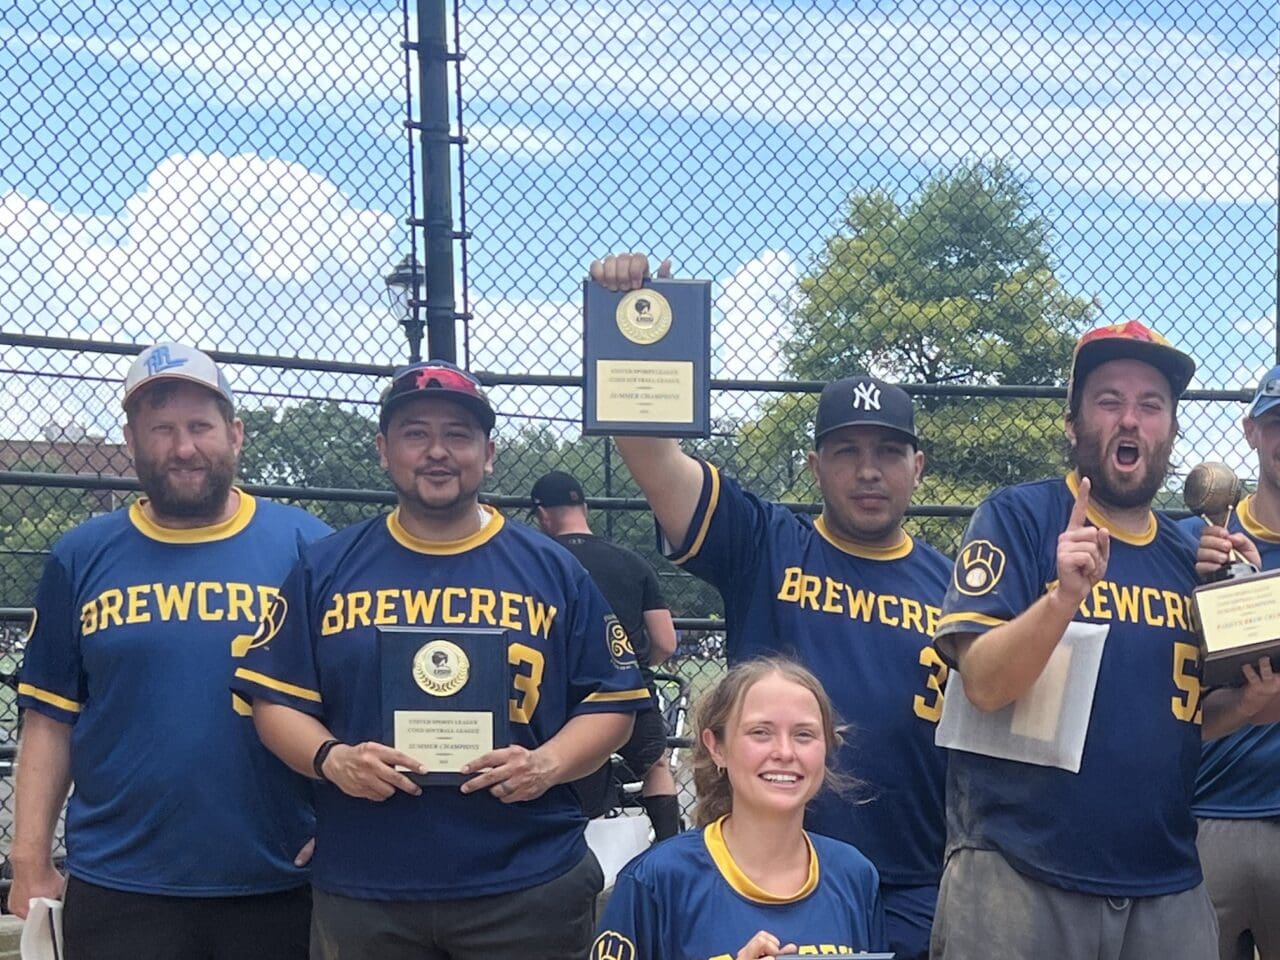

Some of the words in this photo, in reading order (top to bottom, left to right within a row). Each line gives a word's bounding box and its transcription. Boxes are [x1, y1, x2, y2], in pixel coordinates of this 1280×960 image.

[853, 382, 881, 410] NY
[321, 587, 557, 640] BREWCREW
[1046, 579, 1197, 631] EWCR
[1171, 641, 1203, 725] 5
